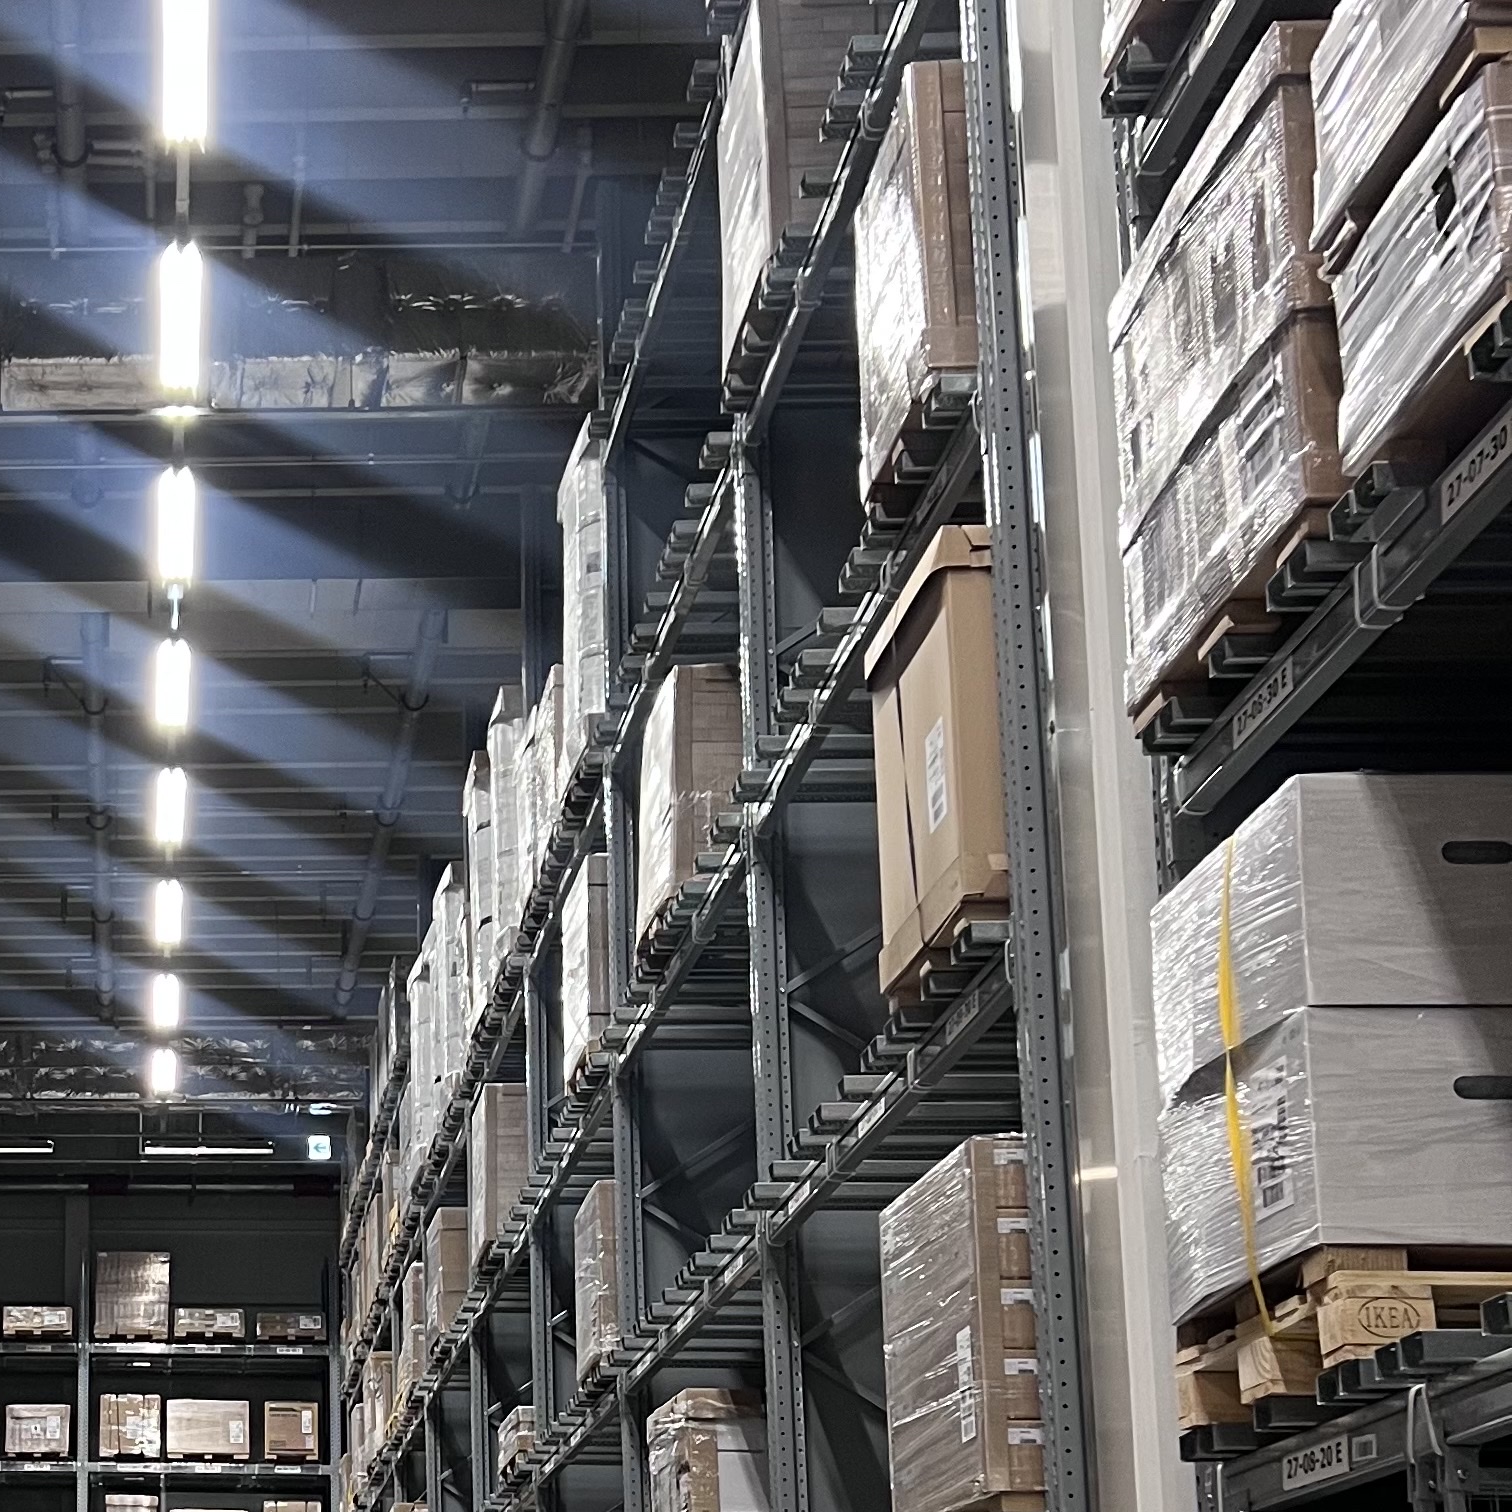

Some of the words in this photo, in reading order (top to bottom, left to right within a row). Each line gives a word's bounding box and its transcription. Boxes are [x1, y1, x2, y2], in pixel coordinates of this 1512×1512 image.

[1447, 424, 1508, 507] 27-07-30
[1281, 667, 1287, 689] E
[1365, 1306, 1414, 1329] IKEA
[1336, 1441, 1342, 1463] E
